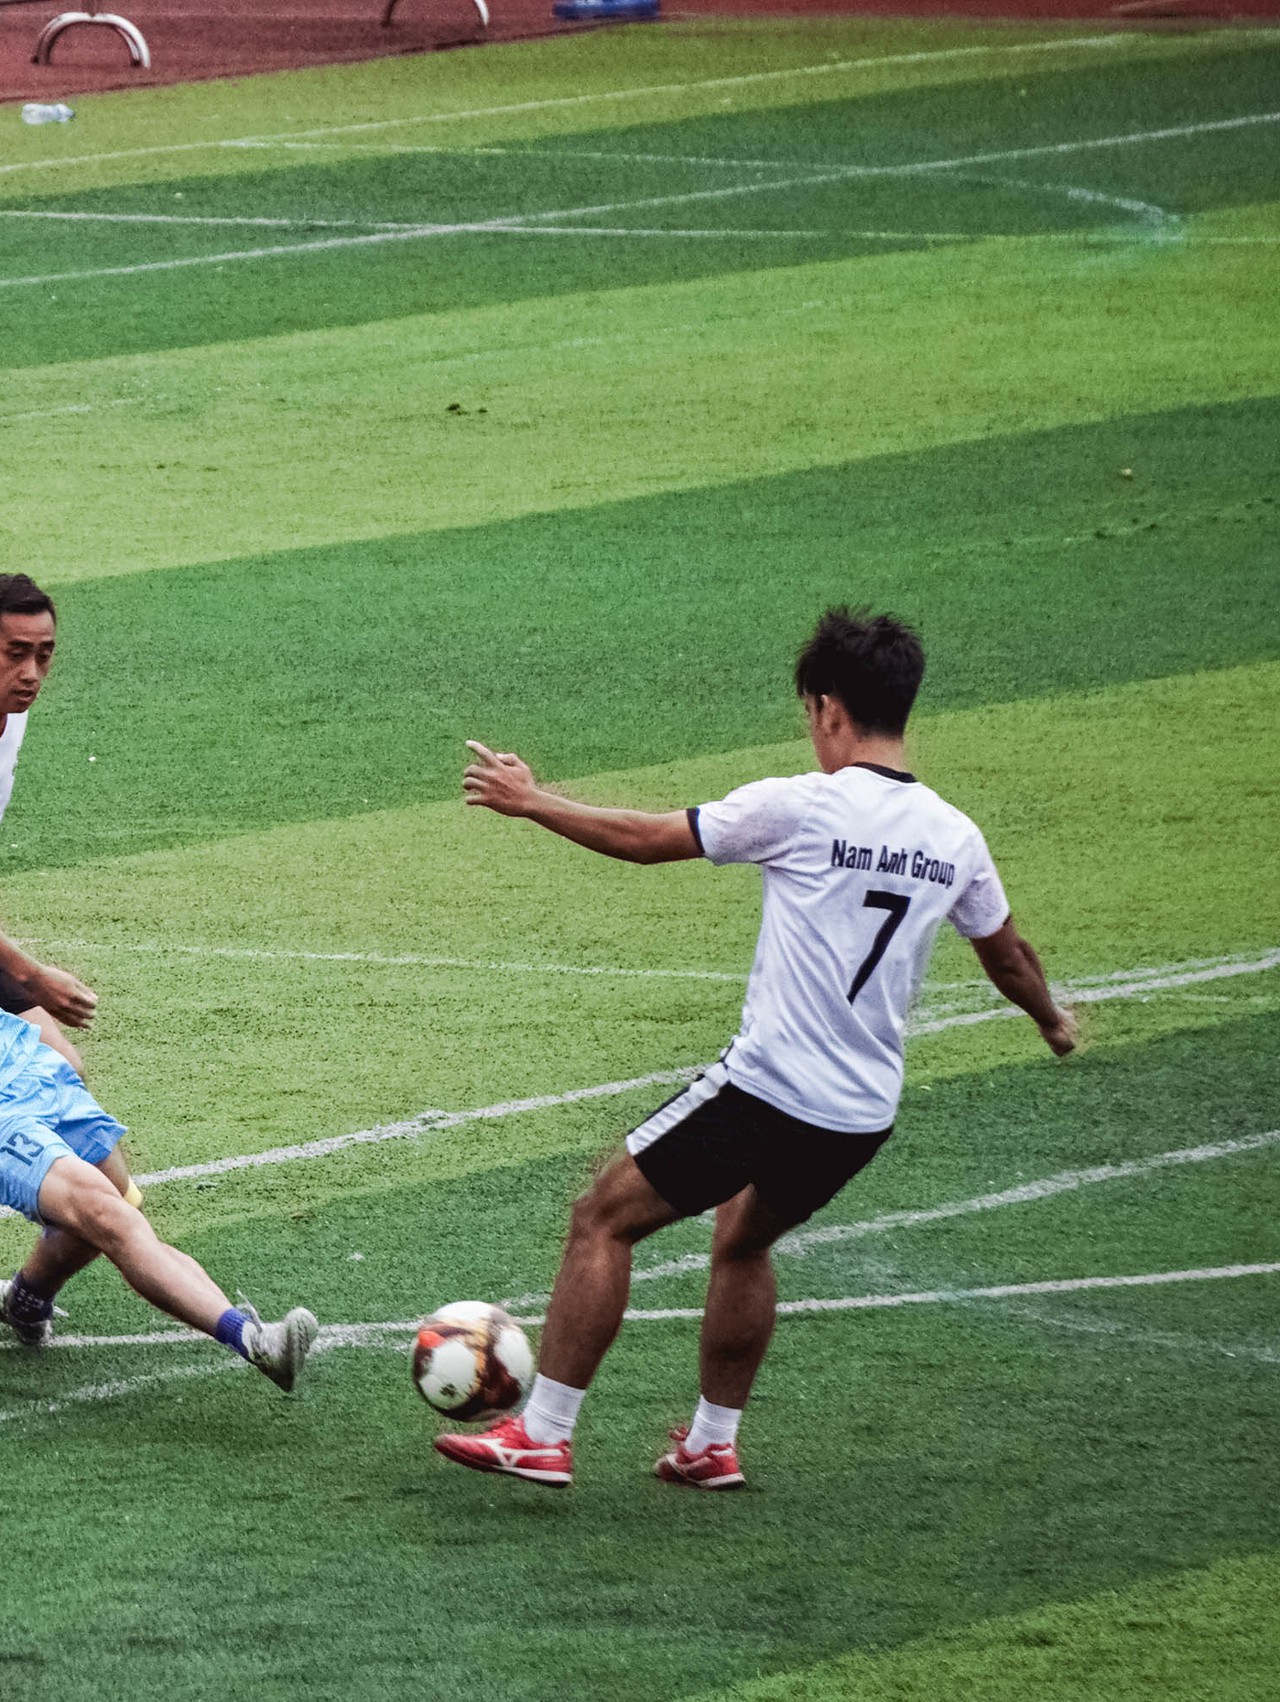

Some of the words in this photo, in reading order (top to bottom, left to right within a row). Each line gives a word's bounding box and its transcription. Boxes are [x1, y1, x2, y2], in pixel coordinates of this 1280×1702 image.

[831, 839, 873, 871] Nam
[876, 845, 908, 876] Anh
[911, 850, 956, 889] Group
[846, 889, 912, 1006] 7
[0, 1132, 44, 1166] 13
